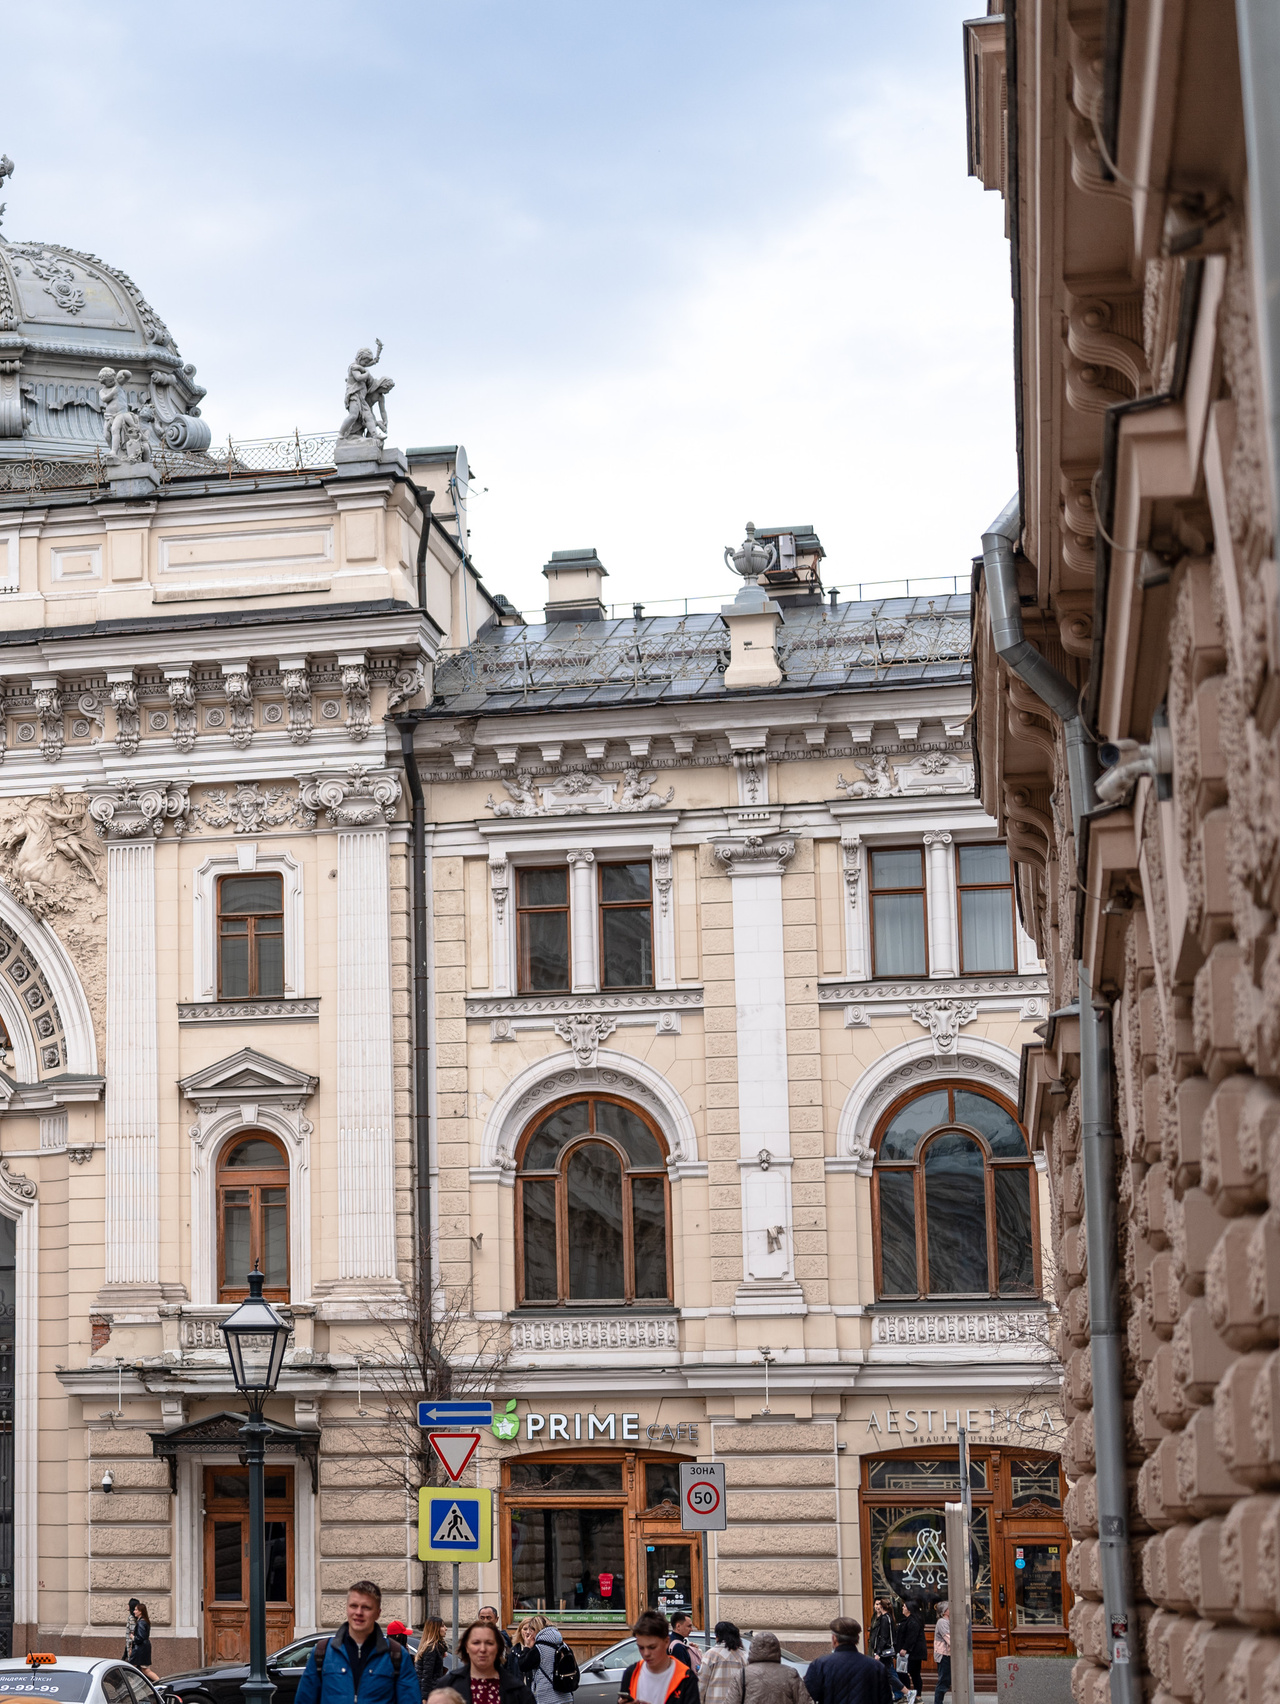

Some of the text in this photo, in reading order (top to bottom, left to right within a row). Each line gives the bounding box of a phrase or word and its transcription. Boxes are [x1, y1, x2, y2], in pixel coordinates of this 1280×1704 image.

[526, 1413, 699, 1440] PRIME CAFE
[866, 1408, 1056, 1433] AESTHETICA
[912, 1435, 1009, 1443] BEAUTY UTIQUE
[690, 1467, 715, 1475] ЗОНА
[694, 1491, 712, 1505] 50
